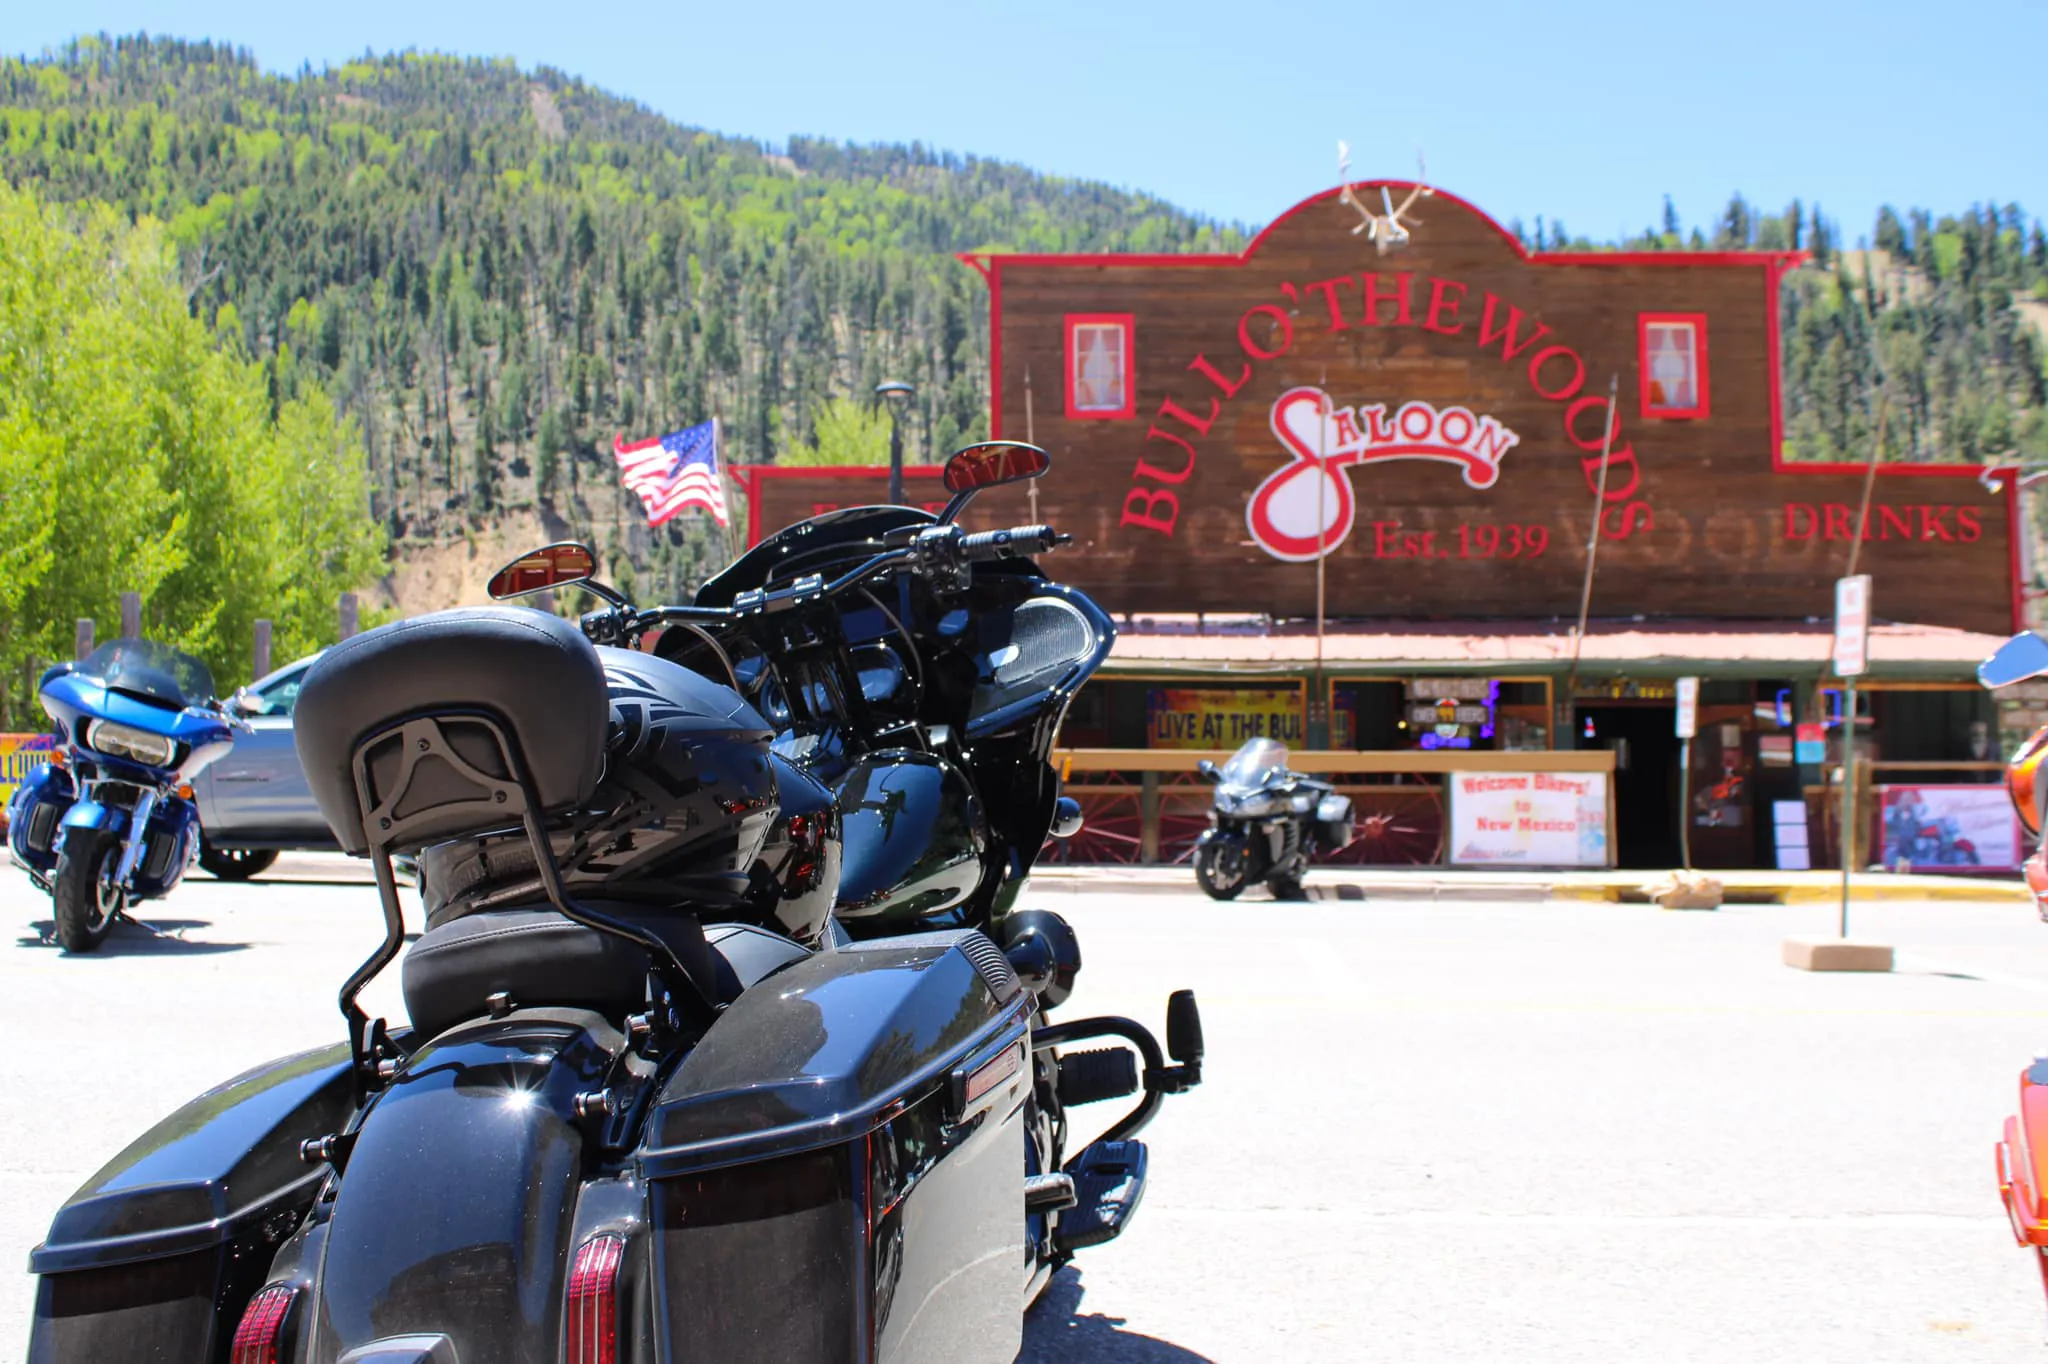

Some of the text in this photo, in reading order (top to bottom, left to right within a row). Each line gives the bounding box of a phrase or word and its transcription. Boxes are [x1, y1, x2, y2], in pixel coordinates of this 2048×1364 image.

[1247, 387, 1516, 560] SALOON
[1784, 502, 1983, 541] DRINKS
[1373, 521, 1448, 559] Est.
[1457, 523, 1549, 560] 1939
[1157, 711, 1196, 740] LIVE
[1202, 712, 1225, 740] AT
[1229, 712, 1266, 740] THE
[1462, 777, 1528, 795] Welcome
[1515, 800, 1532, 813] to
[1476, 817, 1577, 833] New Mexico
